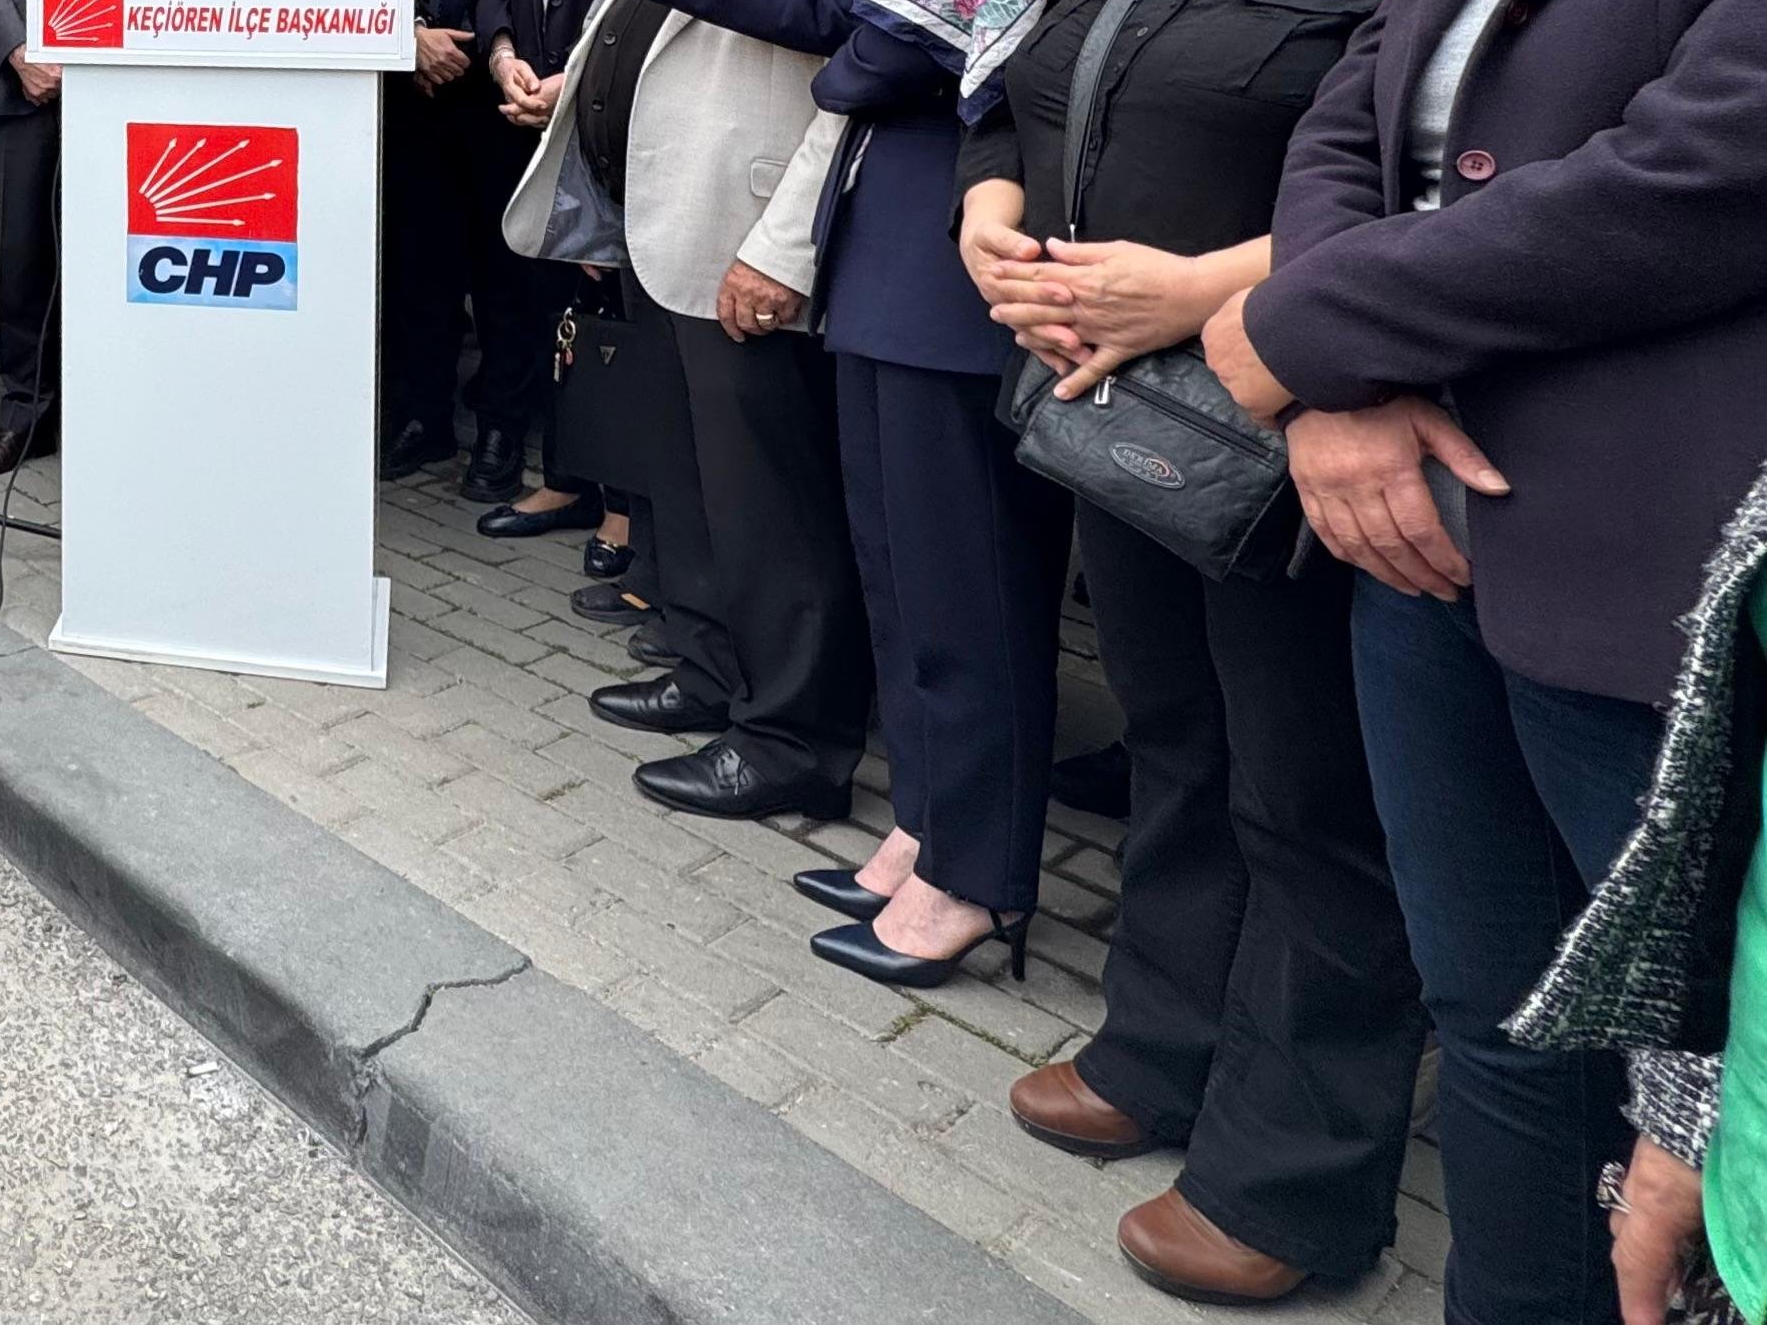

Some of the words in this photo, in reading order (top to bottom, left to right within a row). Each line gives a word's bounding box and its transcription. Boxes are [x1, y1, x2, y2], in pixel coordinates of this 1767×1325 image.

[127, 0, 223, 38] KEÇİÖREN
[228, 0, 271, 40] İLÇE
[275, 1, 396, 41] BAŞKANLIĞI
[138, 246, 286, 298] CHP
